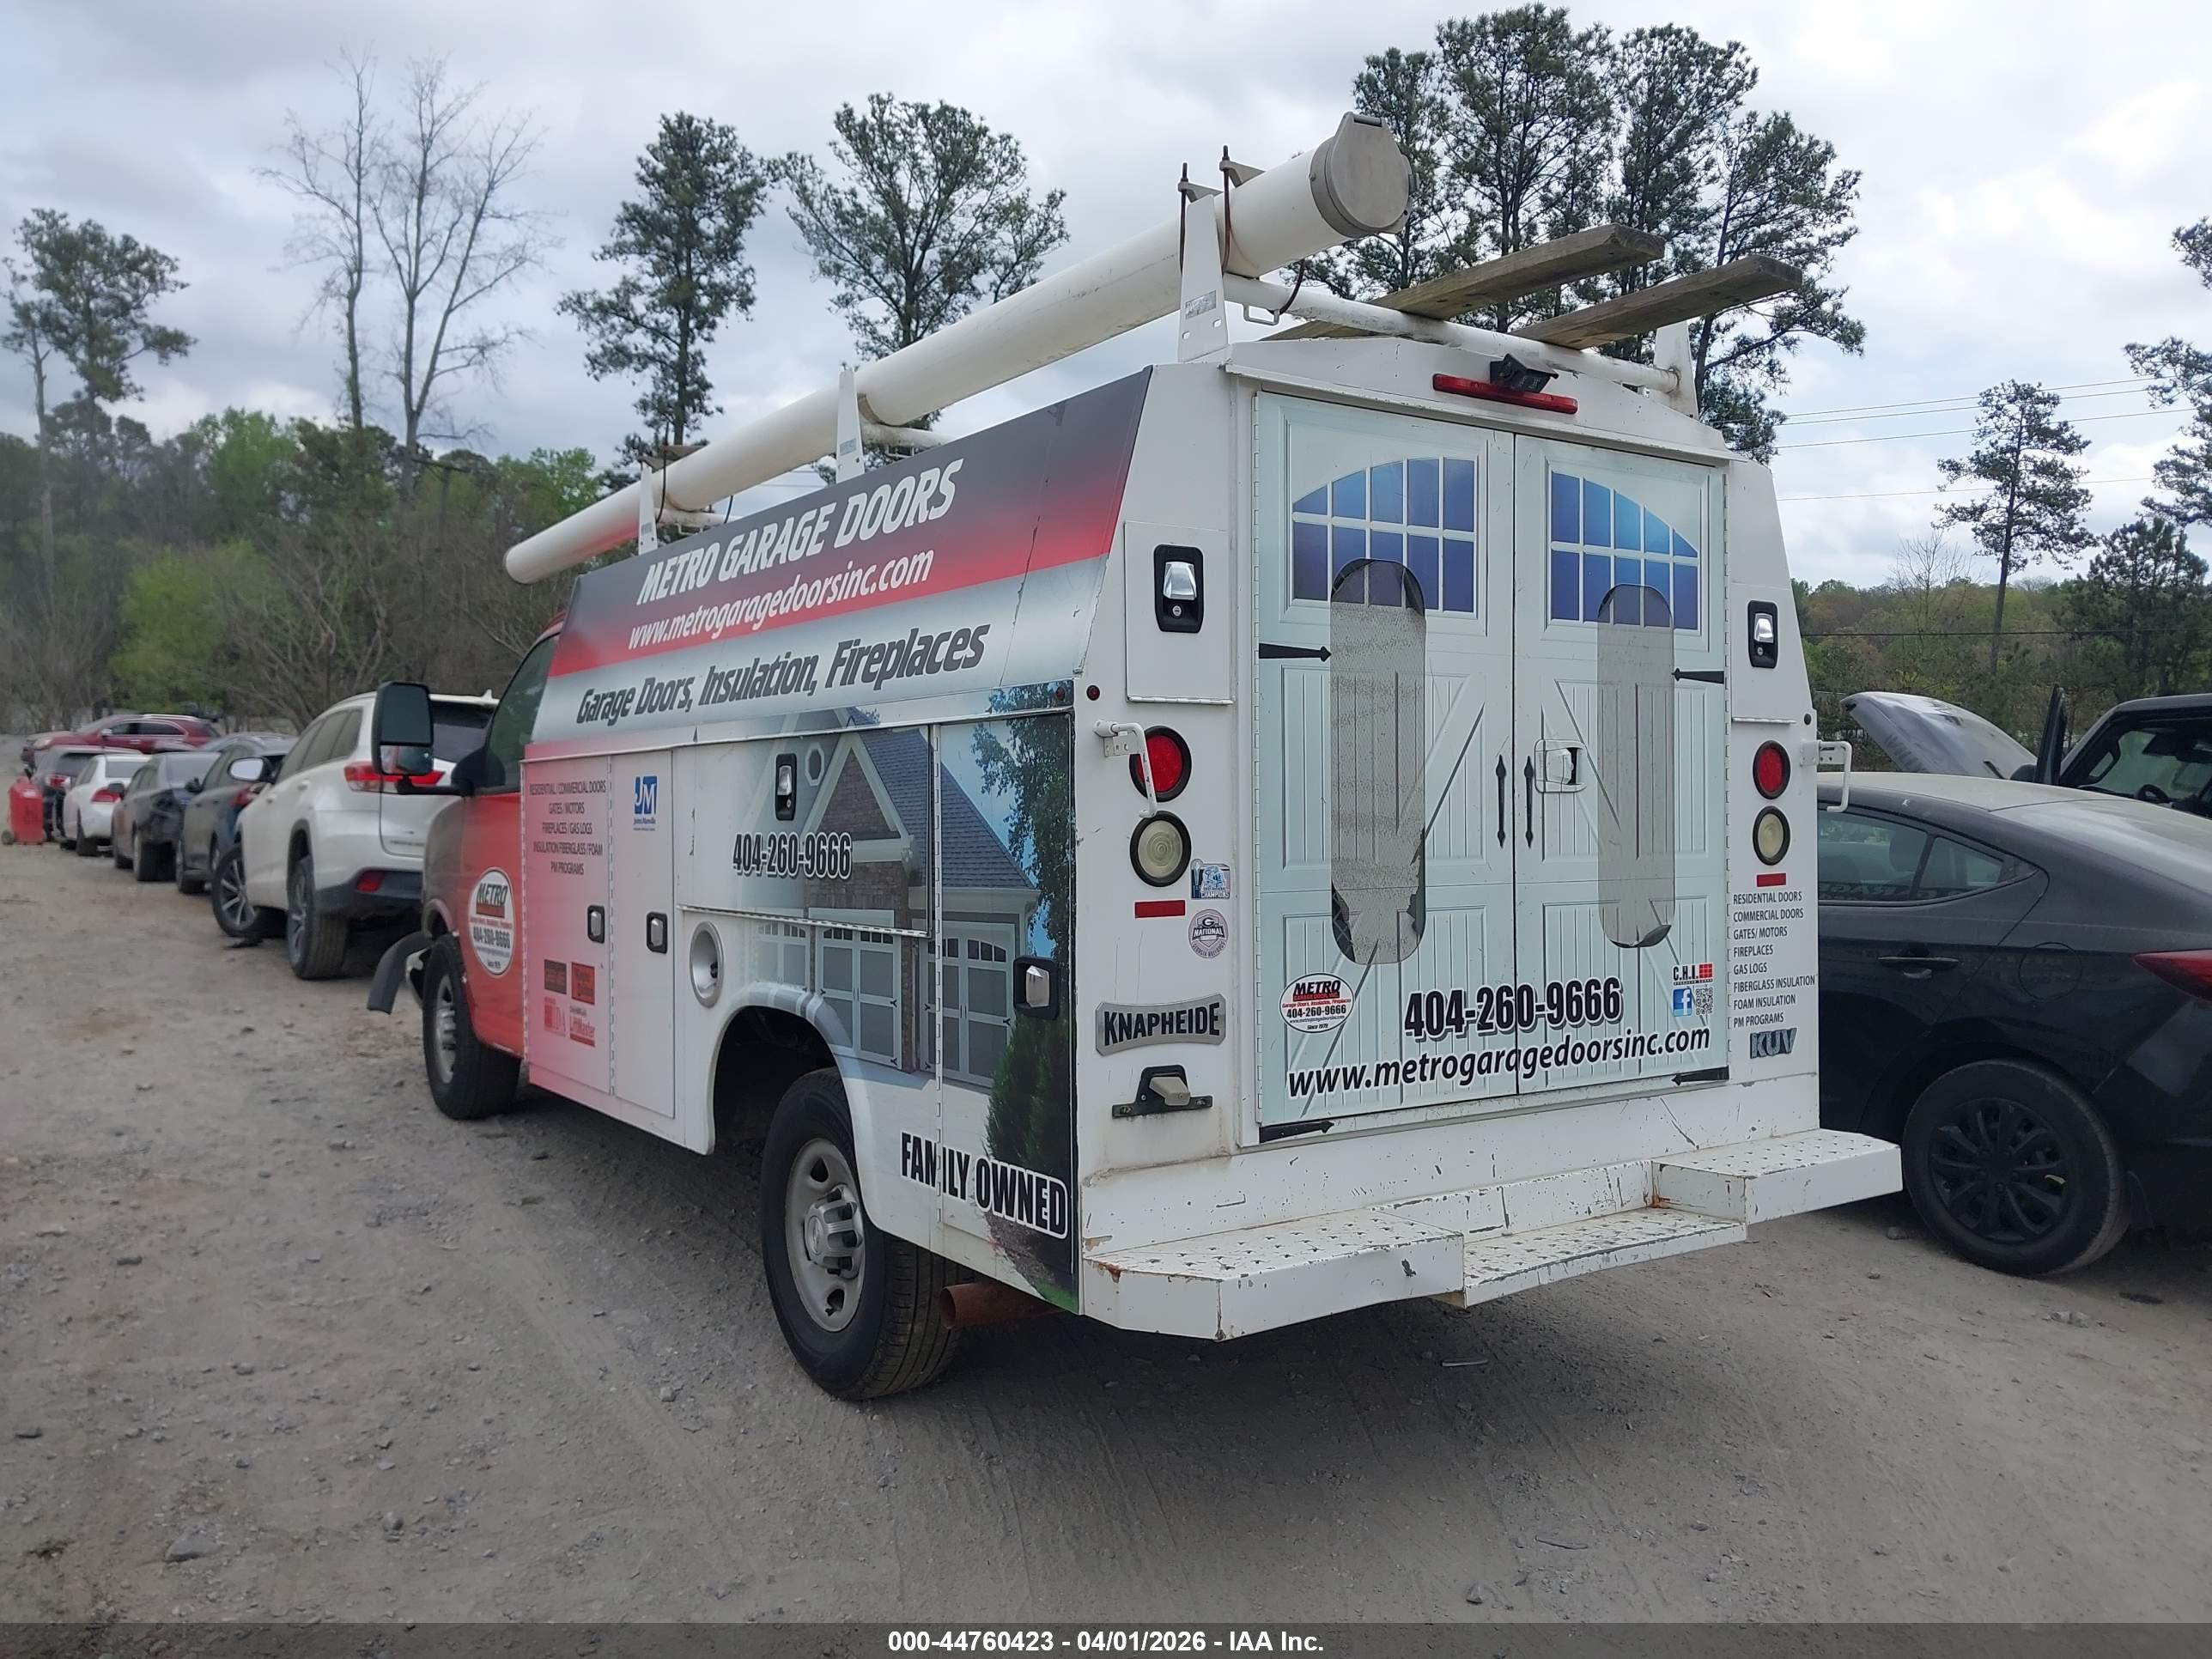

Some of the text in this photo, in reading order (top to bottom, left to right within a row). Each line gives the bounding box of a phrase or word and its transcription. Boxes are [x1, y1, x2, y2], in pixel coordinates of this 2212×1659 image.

[636, 458, 964, 605] METRO GARAGE DOORS
[628, 550, 934, 650] www.metrogaragedoorsinc.com
[576, 624, 991, 726] Garage Doors, Insulation, Fireplaces
[588, 780, 606, 793] DOORS
[634, 775, 658, 815] JM
[549, 803, 562, 814] GATES
[542, 822, 568, 834] FIREPLACES
[570, 822, 580, 834] GAS
[580, 822, 592, 835] LOGS
[732, 832, 853, 880] 404-260-9666
[477, 883, 508, 906] METRO
[1733, 890, 1802, 904] RESIDENTIAL DOORS
[1733, 908, 1804, 922] COMMERCIAL DOORS
[1194, 927, 1224, 937] NATIONAL
[1733, 927, 1788, 939] GATES/ MOTORS
[1733, 945, 1773, 957] FIREPLACES
[1673, 964, 1698, 981] C.H.I.
[1733, 962, 1767, 975] GAS LOGS
[1293, 980, 1341, 994] METRO
[1733, 975, 1816, 993] FIBERGLASS INSULATION
[1404, 977, 1624, 1041] 404-260-9666
[1733, 994, 1796, 1010] FOAM INSULATION
[1286, 1005, 1346, 1018] 404-260-9666
[1104, 1002, 1220, 1046] KNAPHEIDE
[1734, 1012, 1784, 1028] PM PROGRAMS
[1750, 1027, 1797, 1059] KUV
[1287, 1027, 1710, 1097] www.metrogaragedoorsinc.com
[975, 1157, 1068, 1240] OWNED
